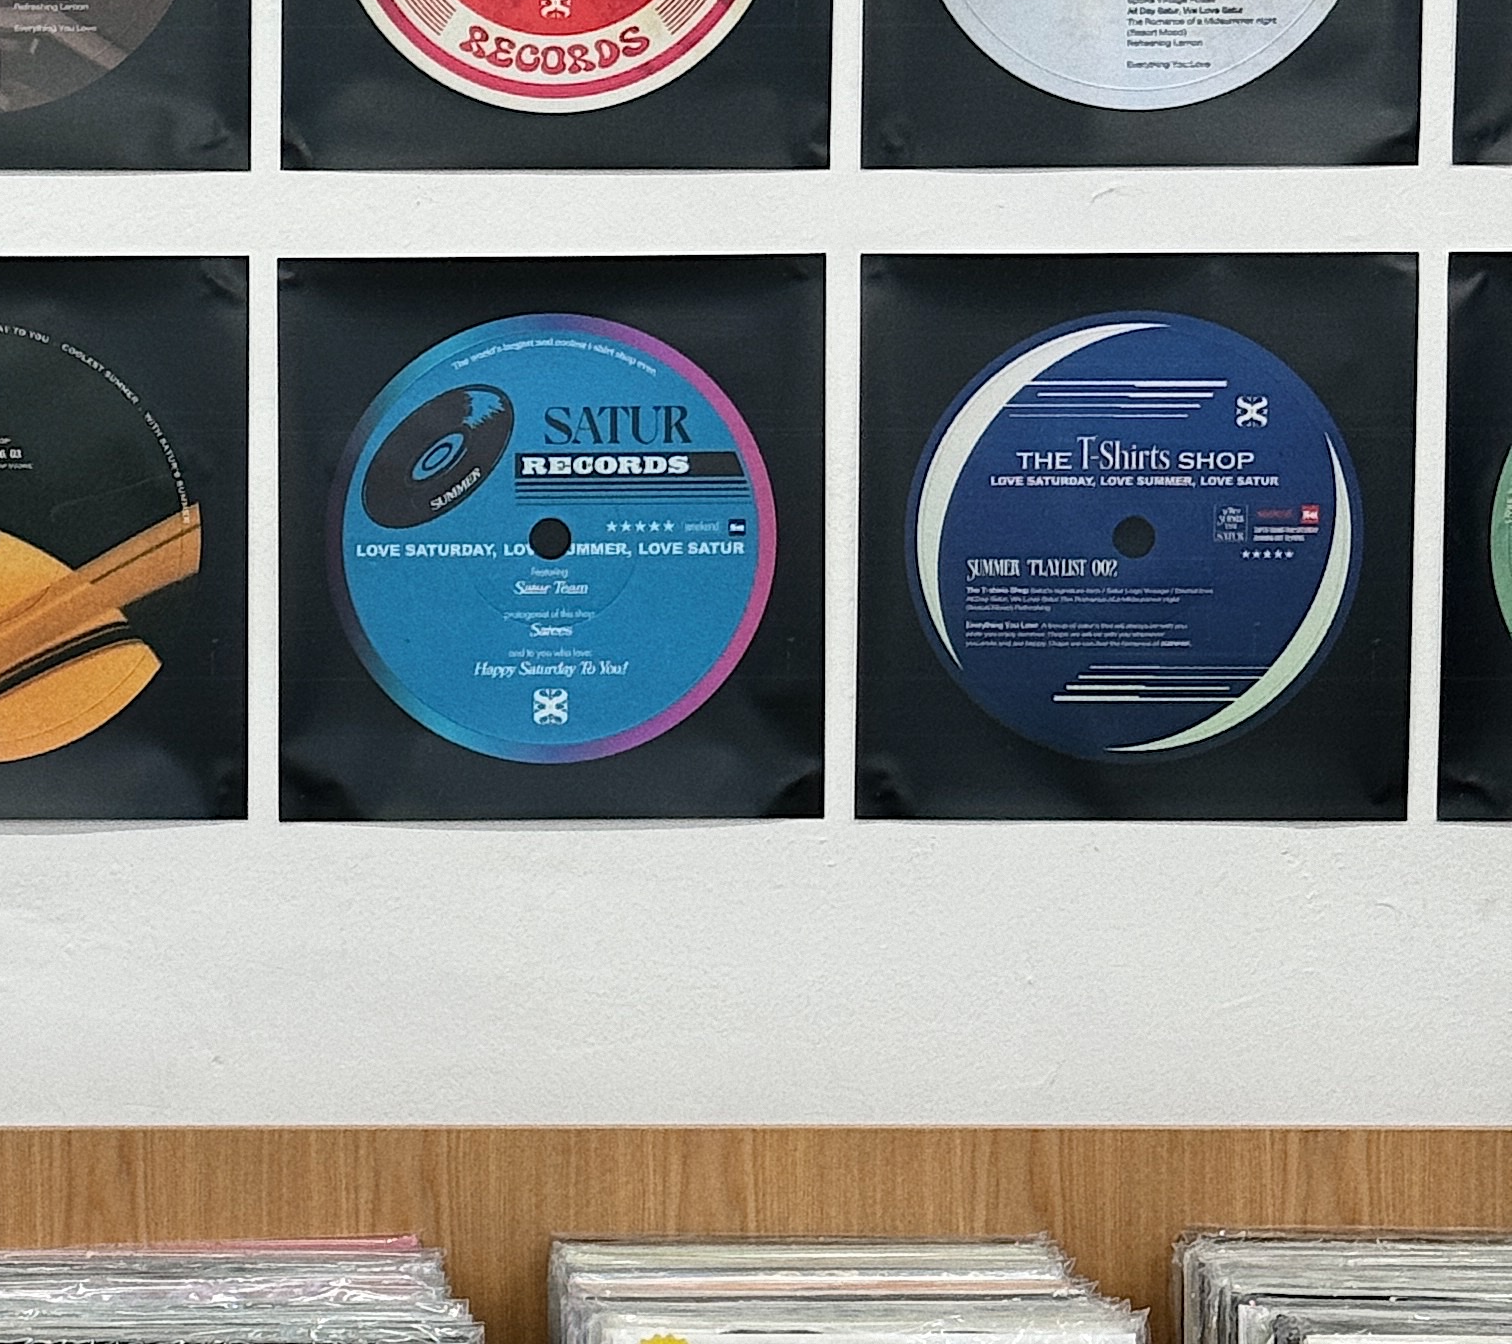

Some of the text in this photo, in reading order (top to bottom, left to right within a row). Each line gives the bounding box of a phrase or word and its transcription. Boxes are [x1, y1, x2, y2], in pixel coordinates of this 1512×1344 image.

[458, 24, 651, 76] RECORDS
[11, 324, 28, 338] TO
[27, 328, 51, 345] YOU
[60, 342, 106, 375] COOLEST
[543, 403, 694, 446] SATUR
[520, 454, 691, 476] RECORDS
[1015, 435, 1255, 471] THE T-Shirts SHOP
[429, 466, 481, 513] SUMMER
[355, 543, 401, 557] LOVE
[404, 543, 498, 559] SATURDAY,
[503, 543, 536, 557] LOV
[638, 541, 685, 555] LOVE
[687, 541, 745, 555] SATUR
[1090, 559, 1119, 577] 002
[474, 660, 630, 678] Happy Saturday To You!
